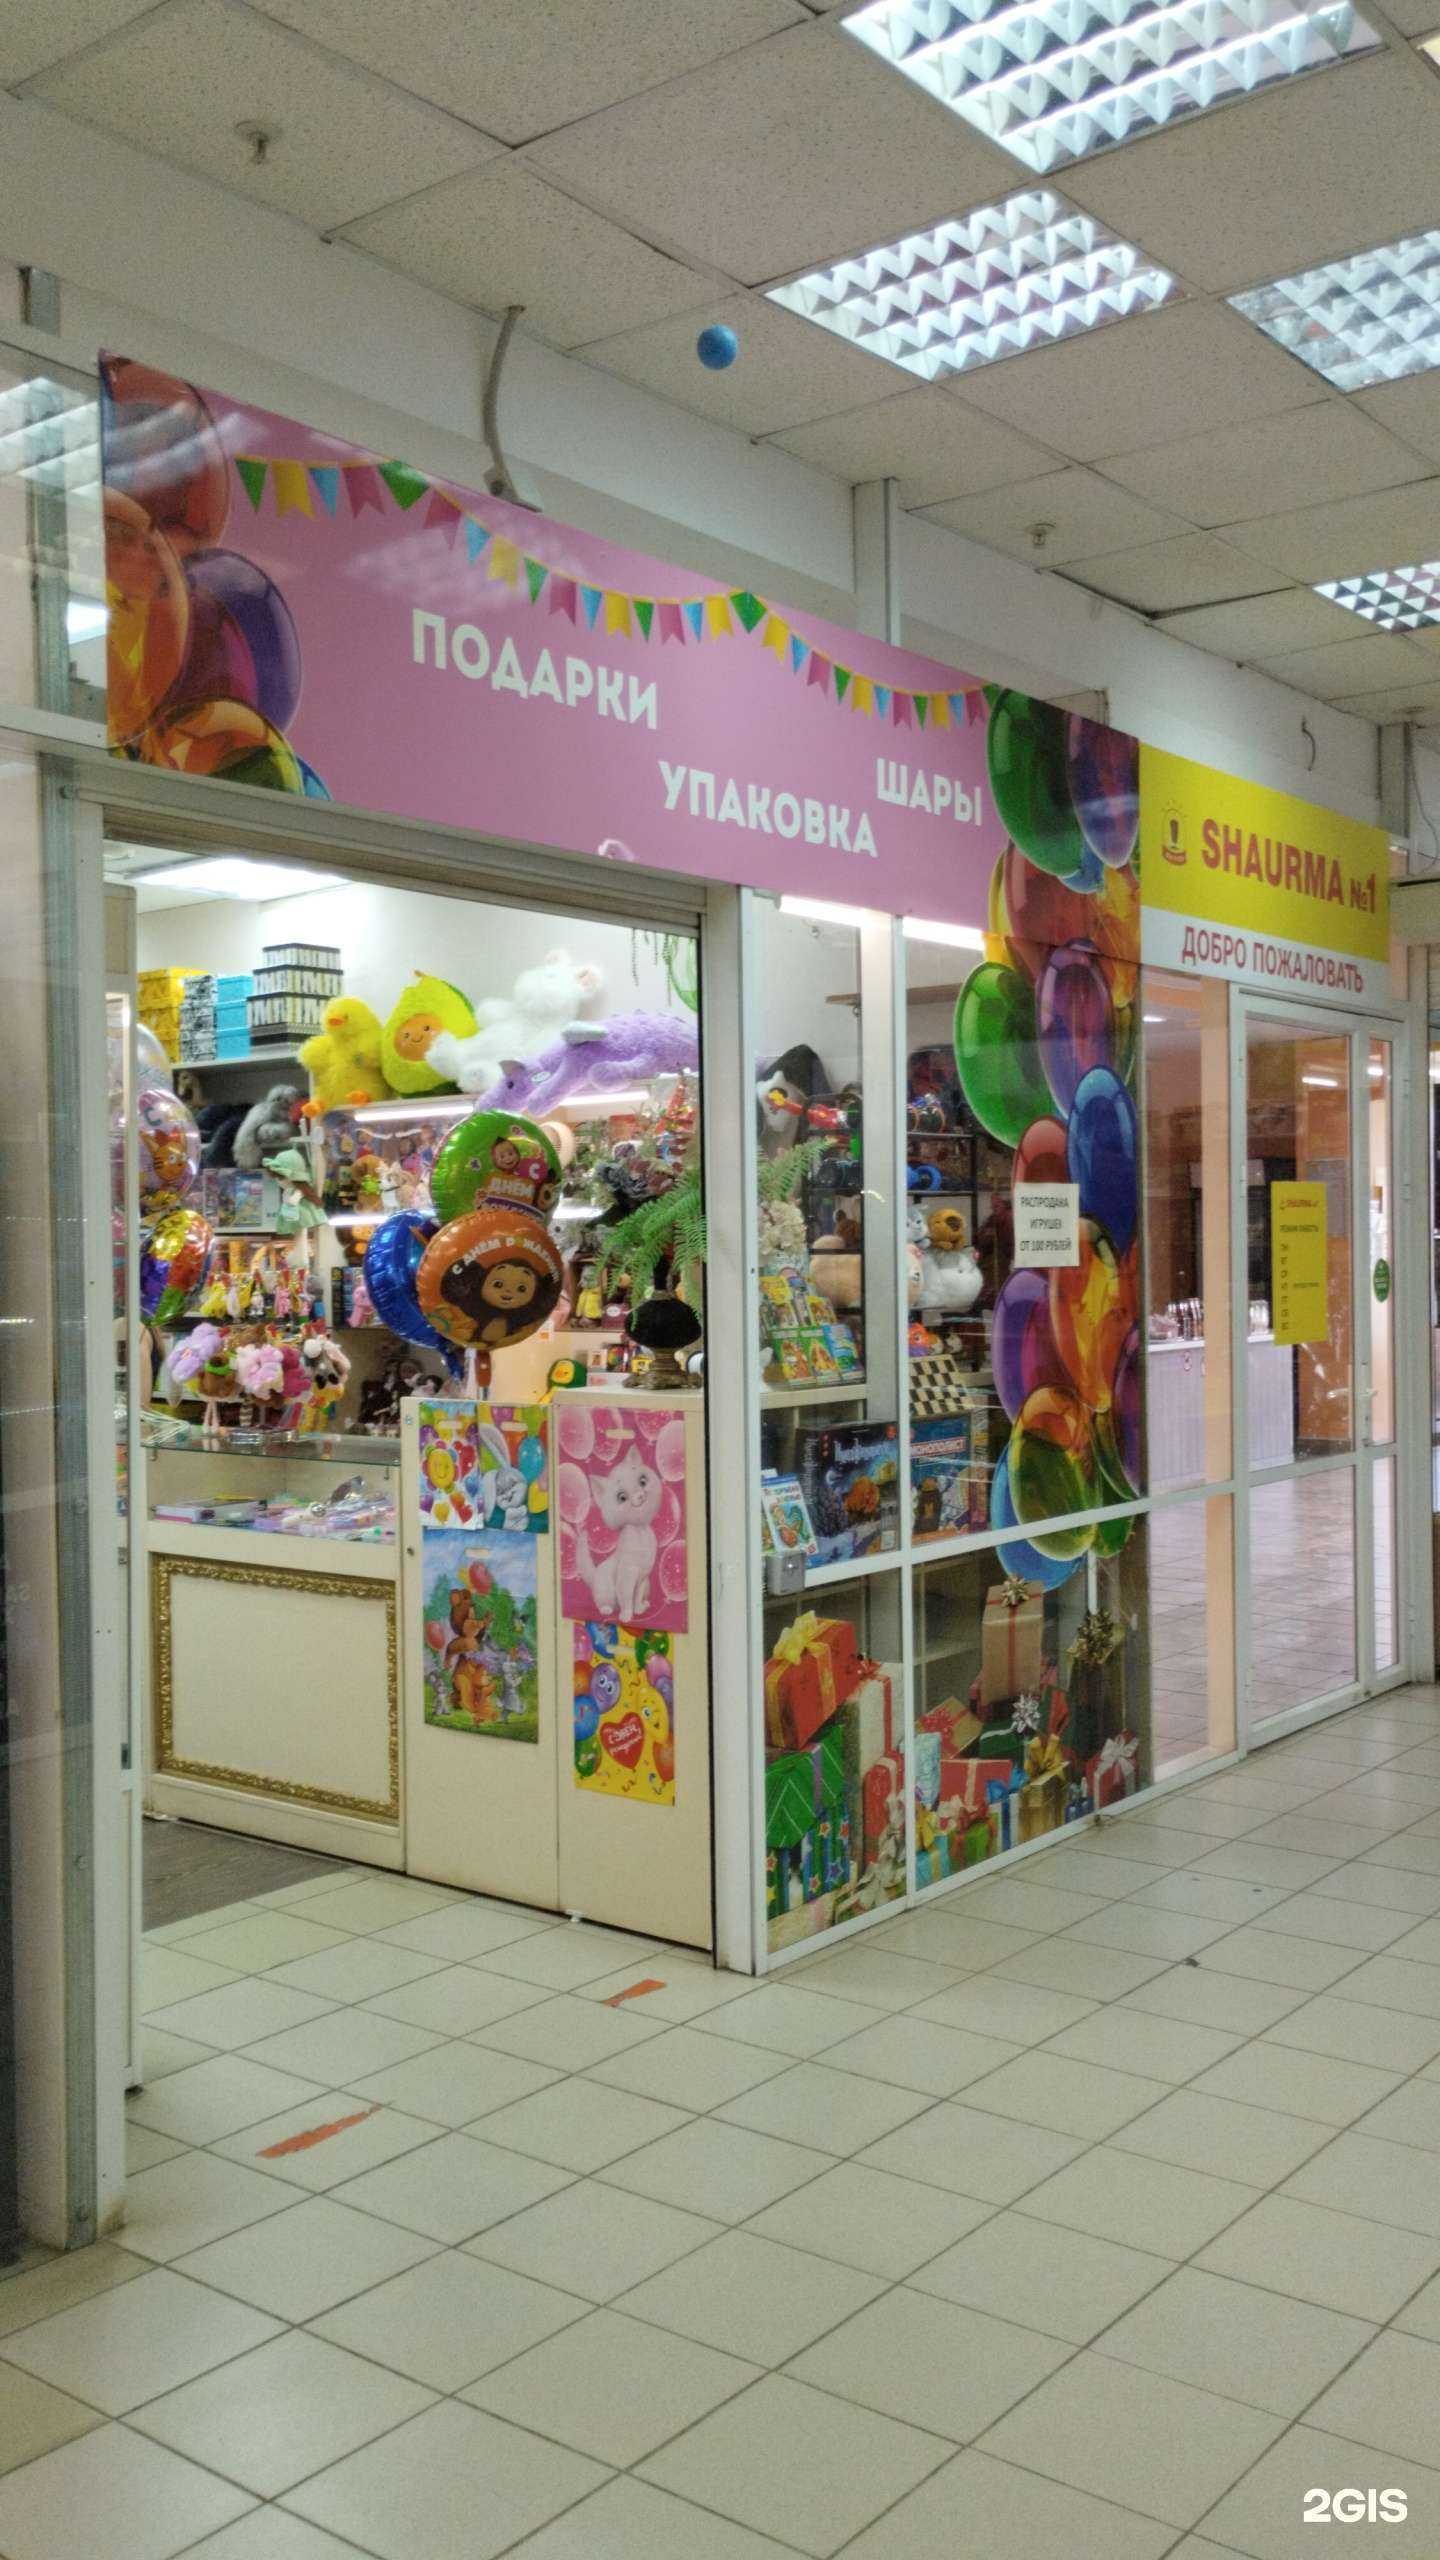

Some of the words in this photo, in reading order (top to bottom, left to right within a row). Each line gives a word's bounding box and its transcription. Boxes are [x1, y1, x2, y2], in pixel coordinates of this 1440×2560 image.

[412, 608, 657, 729] ПОДАРКИ
[658, 760, 878, 857] УПАКОВКА
[876, 758, 981, 826] ШАРЫ
[1201, 819, 1344, 906] SHAURMA
[1350, 873, 1376, 914] №1
[1182, 926, 1246, 968] ДОБРО
[1253, 942, 1363, 993] ПОЖАЛОВАТЬ
